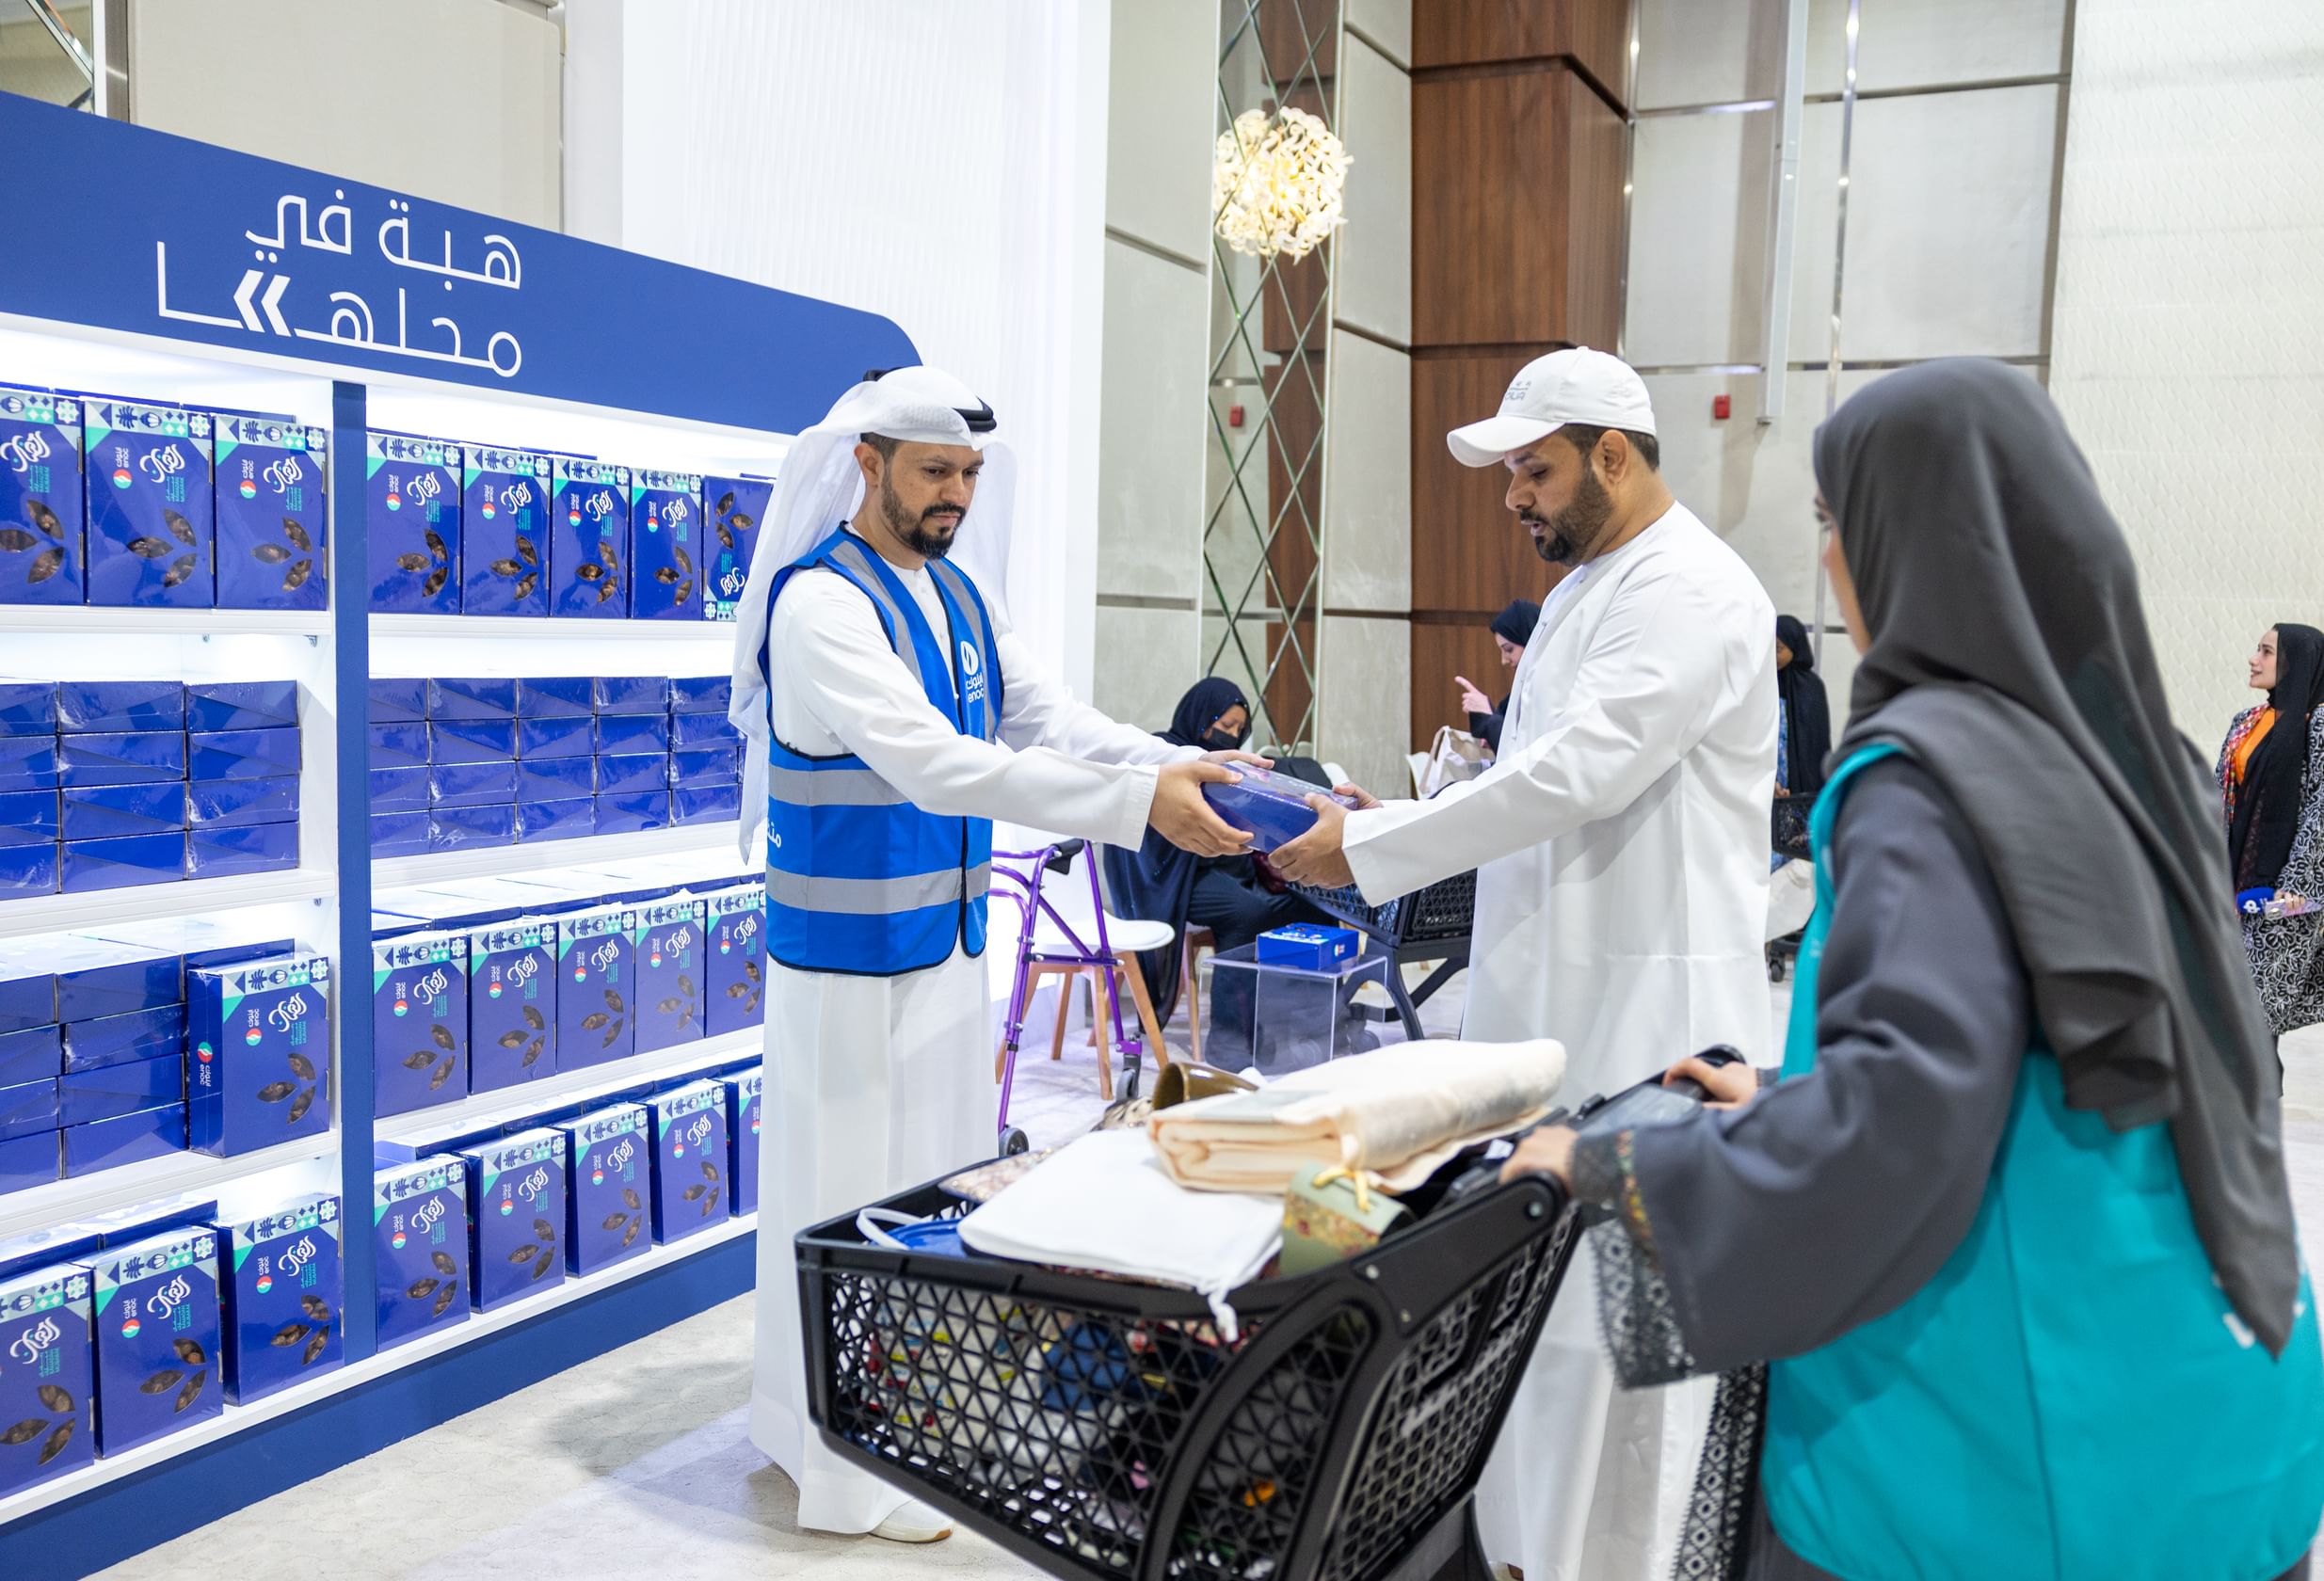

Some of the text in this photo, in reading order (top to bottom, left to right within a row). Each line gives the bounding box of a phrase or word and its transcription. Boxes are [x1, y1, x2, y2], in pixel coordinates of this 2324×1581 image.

[245, 189, 521, 292] هبة في
[156, 241, 521, 377] محلها
